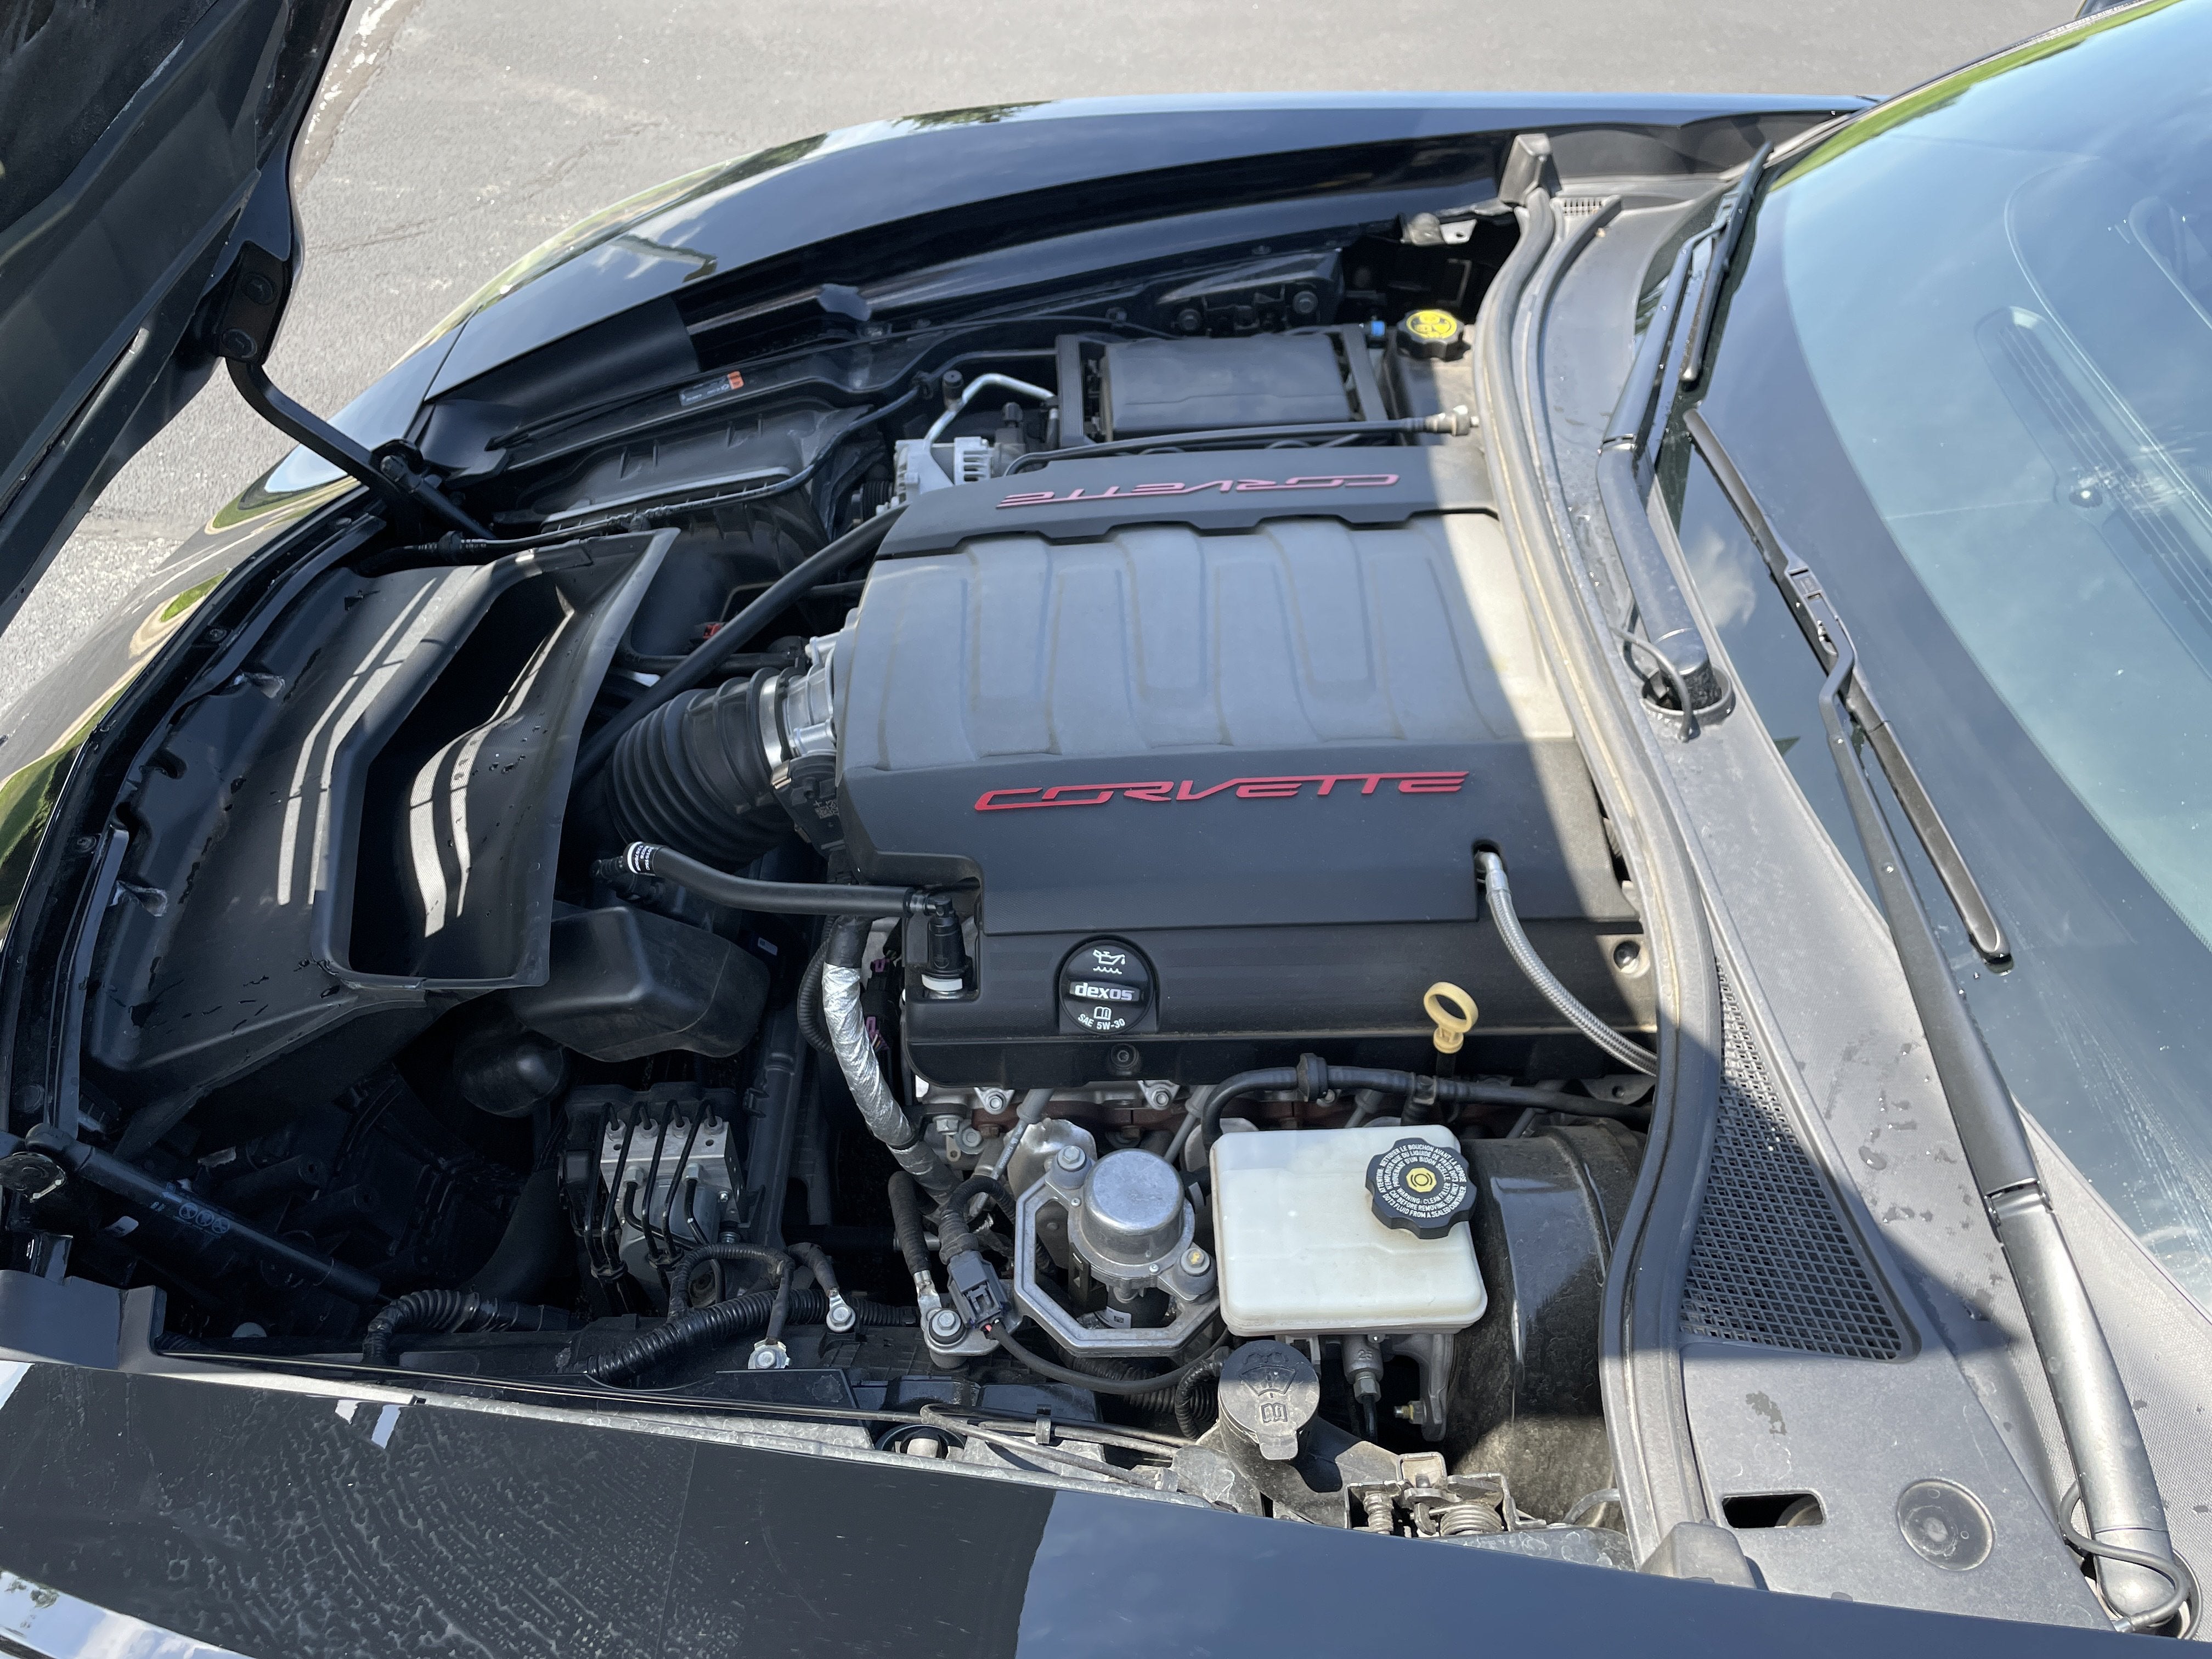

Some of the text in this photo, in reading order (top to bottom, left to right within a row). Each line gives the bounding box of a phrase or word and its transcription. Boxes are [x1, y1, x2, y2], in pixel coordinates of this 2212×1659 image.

[996, 473, 1400, 509] CORVETTE
[974, 771, 1470, 810] CORVETTE
[1075, 982, 1135, 1001] dexos
[1077, 1013, 1126, 1030] SAE 5W-30
[1391, 1155, 1403, 1164] QUE
[1438, 1157, 1453, 1171] FREIN
[1408, 1144, 1434, 1152] BOUCHON
[1434, 1148, 1452, 1160] AVANT
[1448, 1158, 1458, 1166] LA
[1454, 1164, 1467, 1183] DEPOSE
[1419, 1156, 1437, 1166] BIDON
[1389, 1190, 1400, 1199] CAP
[1397, 1197, 1418, 1210] BEFORE
[1444, 1193, 1455, 1204] USE
[1450, 1183, 1459, 1195] ONLY
[1423, 1195, 1442, 1205] CLEAN
[1438, 1182, 1451, 1198] FILLER
[1393, 1203, 1410, 1215] FLUID
[1409, 1210, 1426, 1218] FROM
[1431, 1206, 1451, 1217] SEALED
